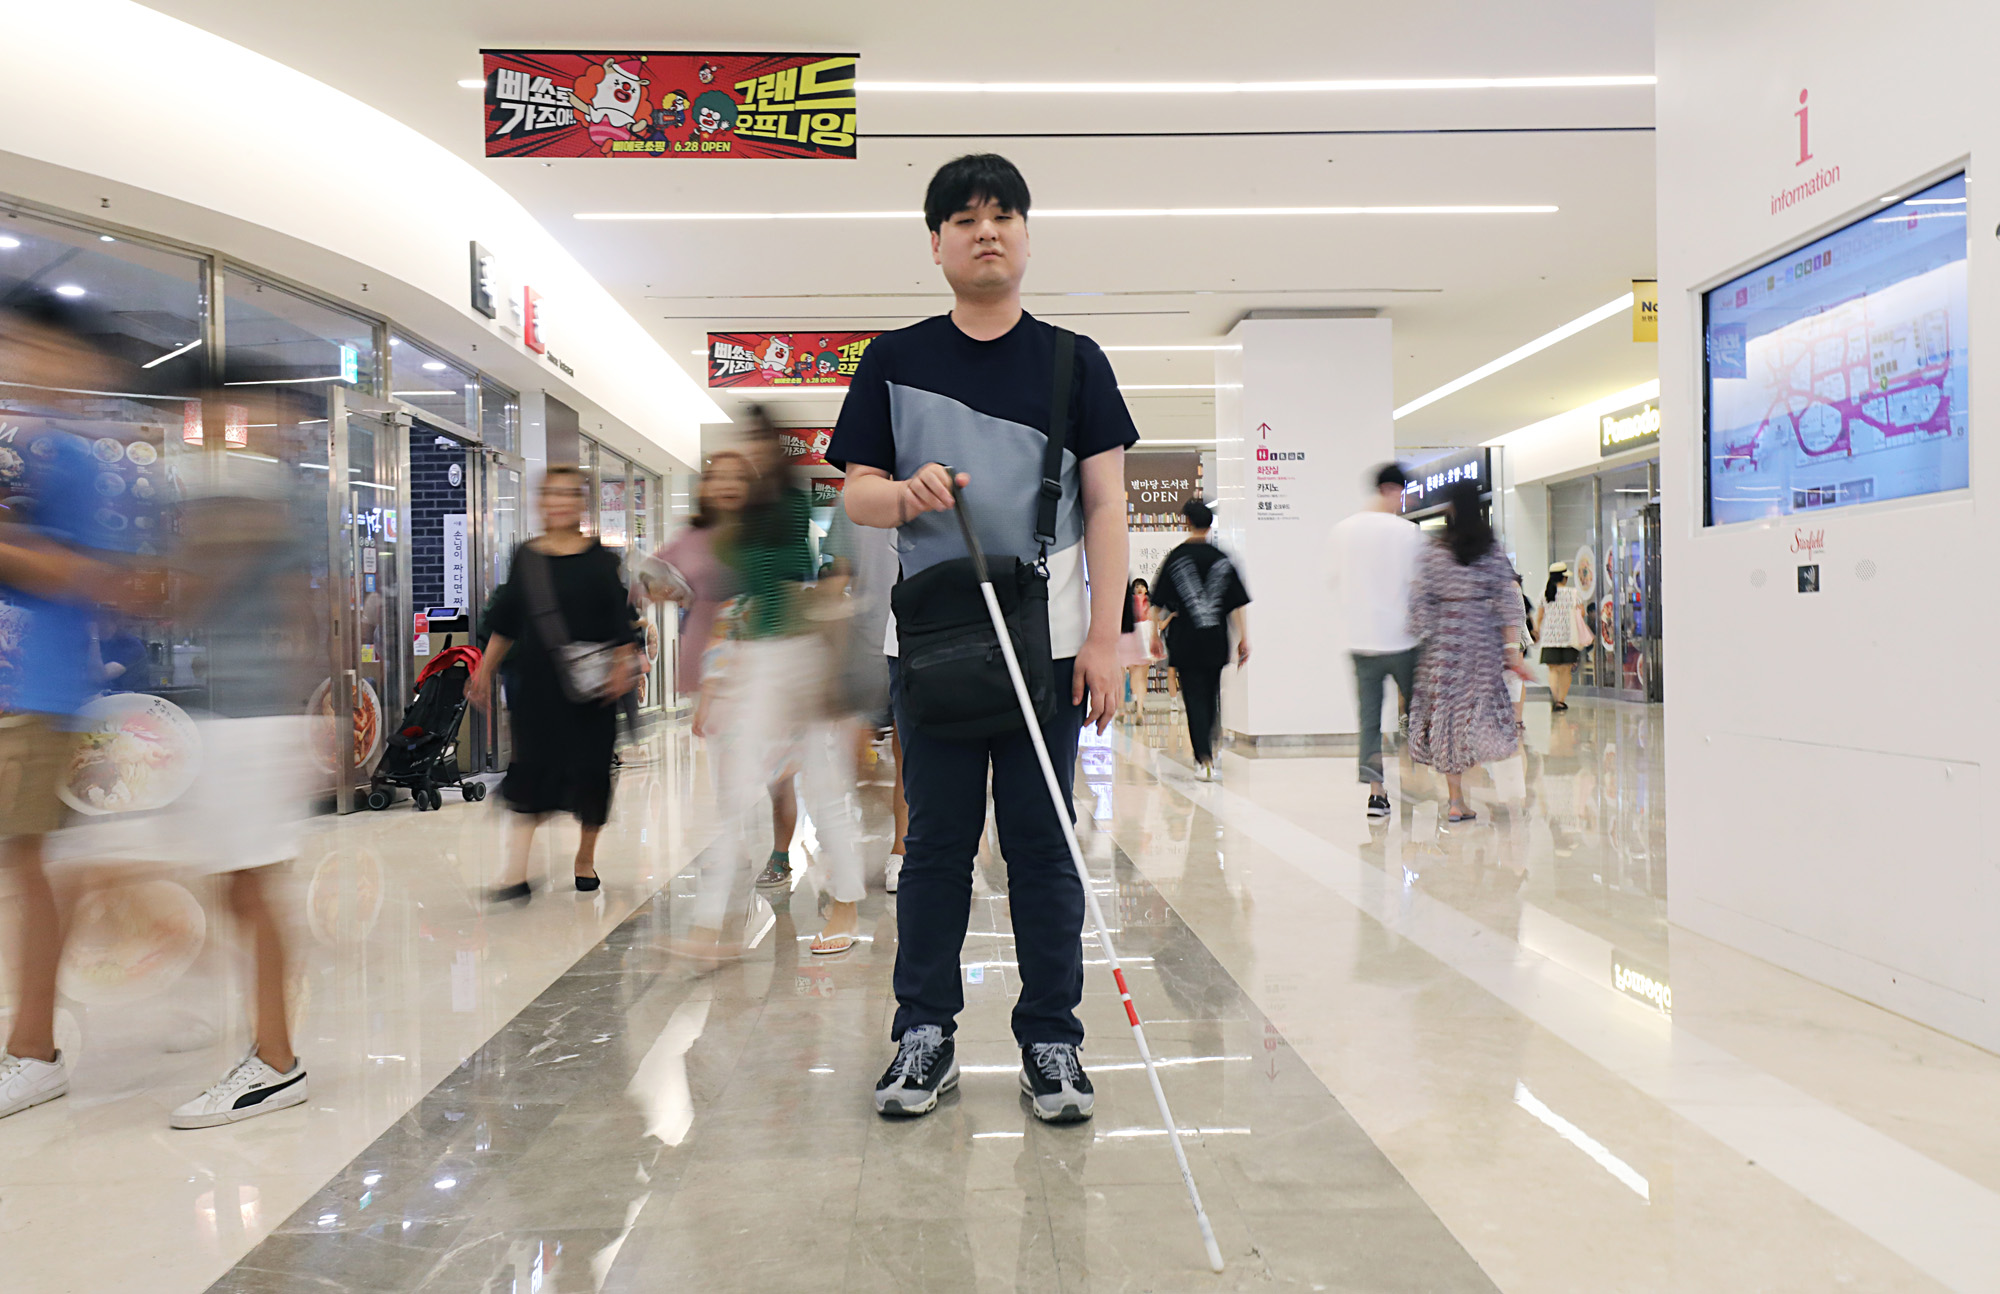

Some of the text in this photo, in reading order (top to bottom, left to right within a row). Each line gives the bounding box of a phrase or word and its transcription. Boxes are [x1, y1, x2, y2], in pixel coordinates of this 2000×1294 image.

[734, 57, 856, 112] 그랜드
[674, 141, 699, 152] 6.28
[701, 141, 731, 152] OPEN
[1771, 165, 1840, 216] information
[837, 337, 876, 362] 그랜
[820, 376, 836, 384] OPEN
[1257, 465, 1279, 475] 화장실
[1131, 479, 1190, 490] 별마당 도서관
[1257, 483, 1279, 492] 카지노
[1141, 491, 1178, 502] OPEN
[1257, 501, 1272, 511] 호텔
[453, 530, 463, 560] 손님이
